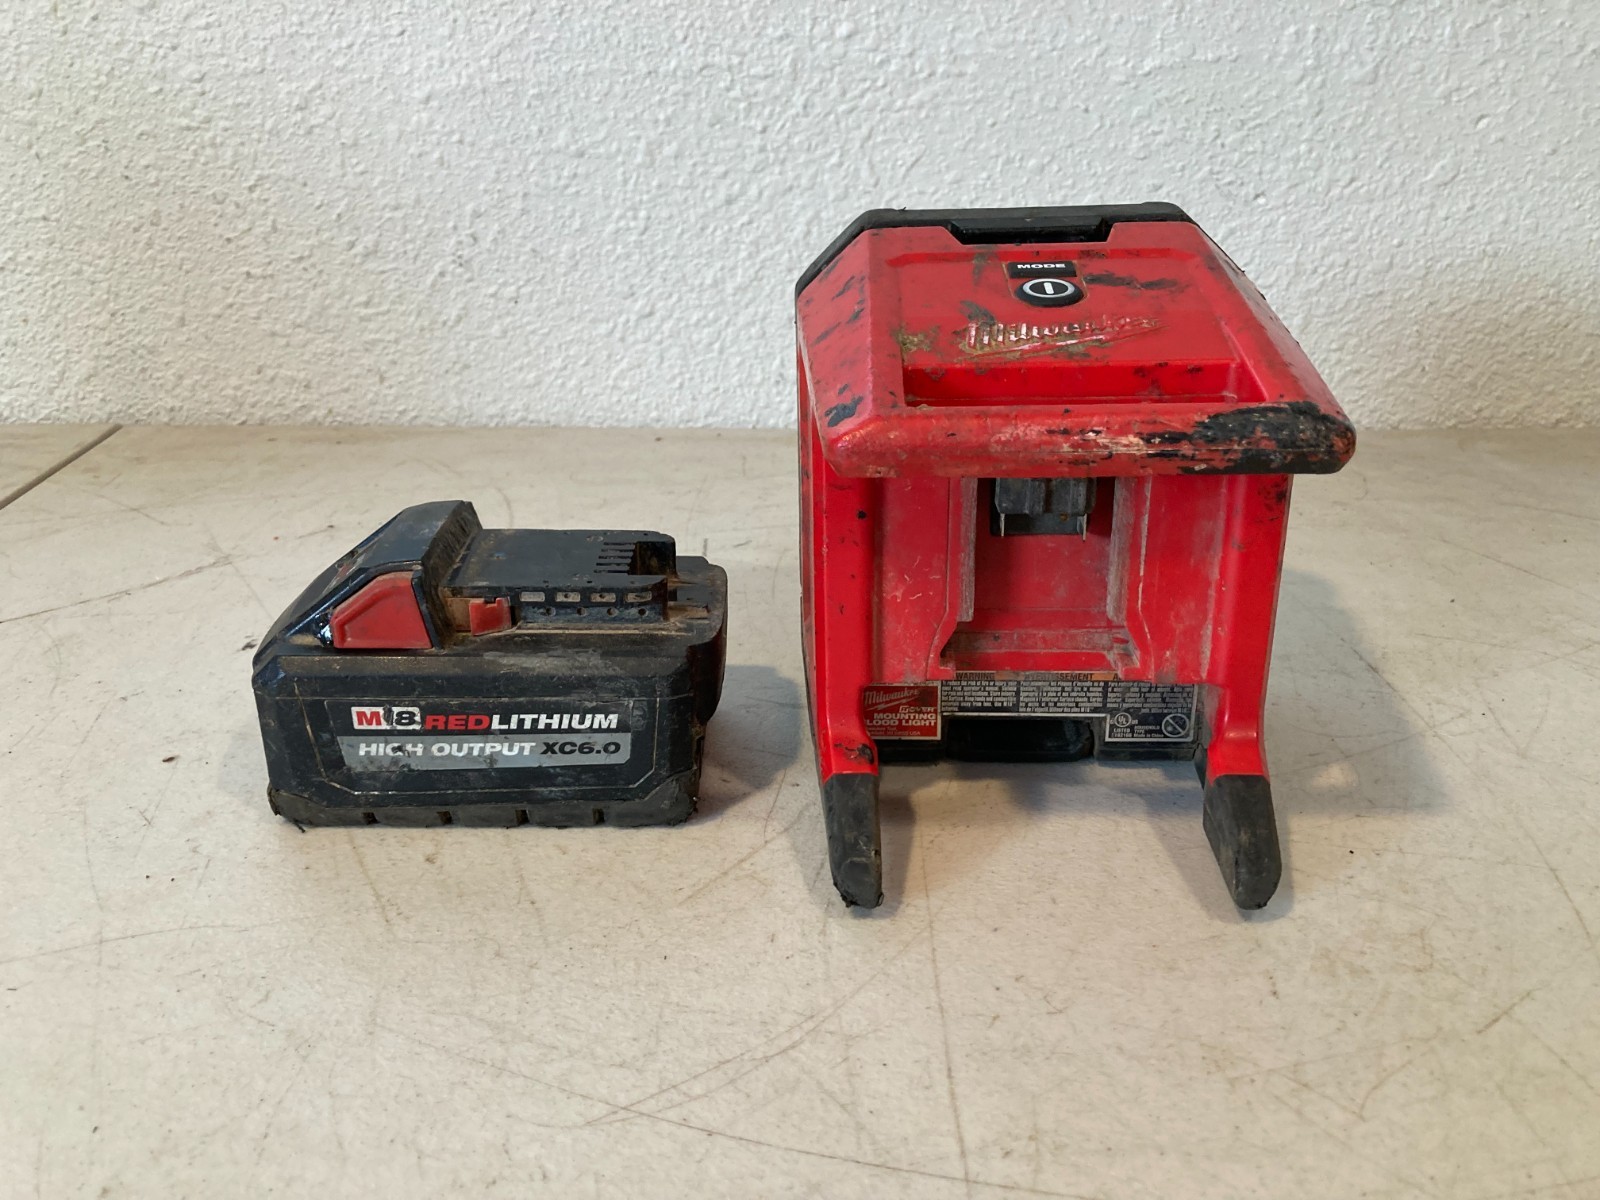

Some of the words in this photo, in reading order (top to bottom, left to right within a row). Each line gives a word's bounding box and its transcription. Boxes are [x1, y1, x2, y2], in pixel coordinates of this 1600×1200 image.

[956, 672, 995, 680] WARNING
[430, 742, 536, 756] OUTPUT
[540, 741, 621, 755] XC6.0
